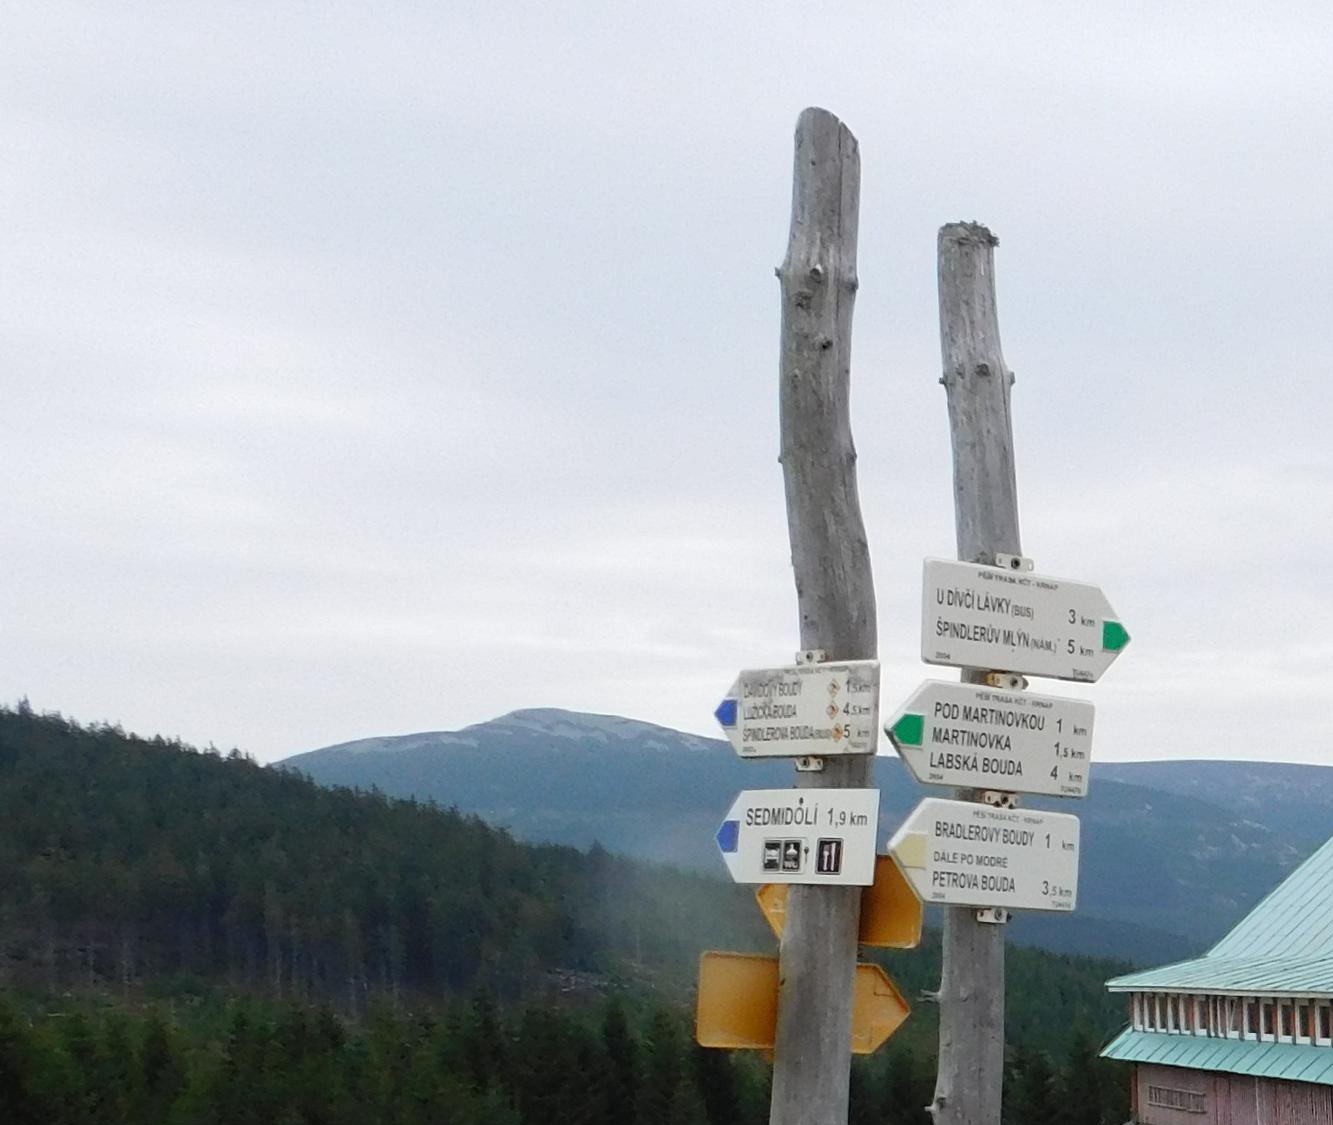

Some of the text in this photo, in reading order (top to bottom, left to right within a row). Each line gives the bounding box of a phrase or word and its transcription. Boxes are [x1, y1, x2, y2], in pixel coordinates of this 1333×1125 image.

[936, 587, 1095, 627] U DÍVČÍ LÁVKY (BUS) 3 km
[1003, 625, 1030, 648] MLÝN
[1067, 639, 1075, 654] 5
[1080, 645, 1094, 657] km
[844, 724, 851, 738] 5
[934, 702, 1087, 736] POD MARTINOVKOU 1 km
[931, 727, 1085, 760] MARTINOVKA 1,5 km
[982, 757, 1023, 776] BOUDA
[1050, 765, 1058, 780] 4
[1069, 771, 1082, 782] km
[746, 803, 868, 828] SEDMIDOLÍ 1,9 km
[935, 821, 1074, 850] BRADLEROVY BOUDY 1 km
[960, 853, 974, 864] PO
[932, 871, 1072, 897] PETROVA BOUDA 3,5 km
